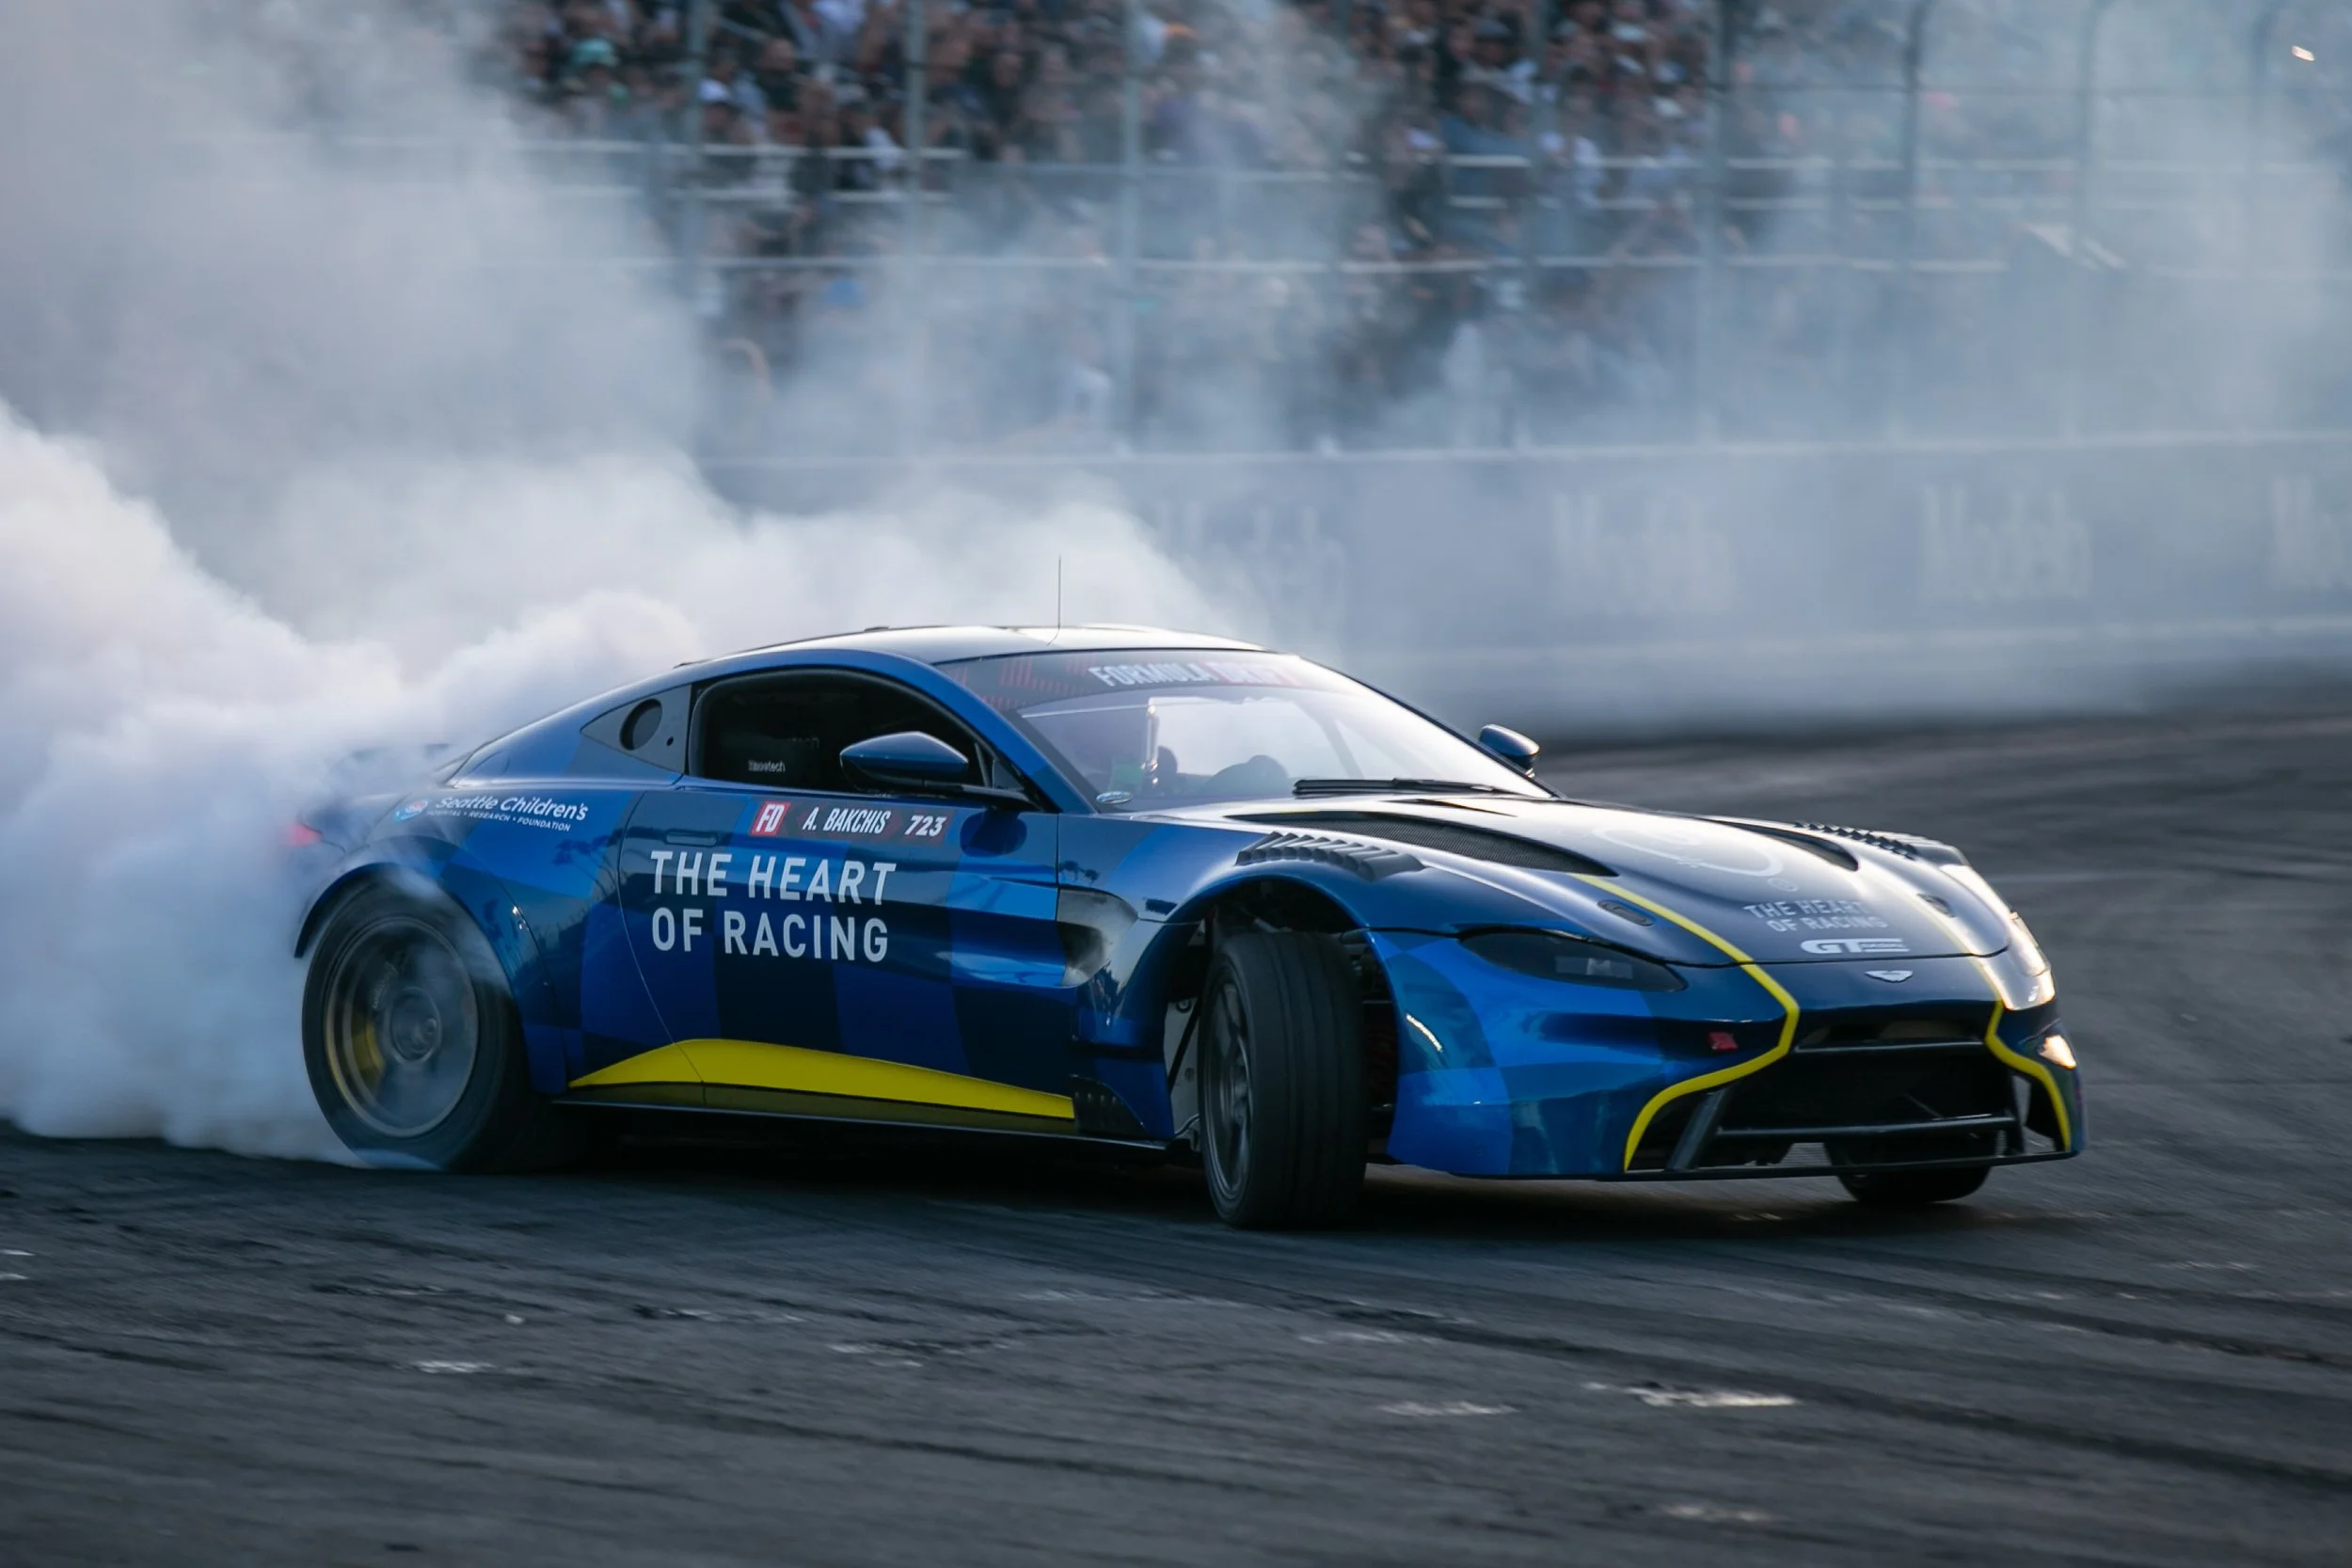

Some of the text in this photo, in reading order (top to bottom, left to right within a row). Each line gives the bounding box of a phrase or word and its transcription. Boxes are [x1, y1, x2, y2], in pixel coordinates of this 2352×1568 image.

[1088, 662, 1219, 687] FORMULA
[435, 796, 589, 821] Seattle Children's
[755, 803, 948, 837] FD A. BAKCHIS 723
[469, 812, 511, 822] RESEARCH
[517, 817, 572, 832] FOUNDATION
[650, 850, 897, 905] THE HEART
[1742, 899, 1869, 919] THE HEART
[651, 907, 888, 962] OF RACING
[1766, 916, 1889, 932] OF RACING
